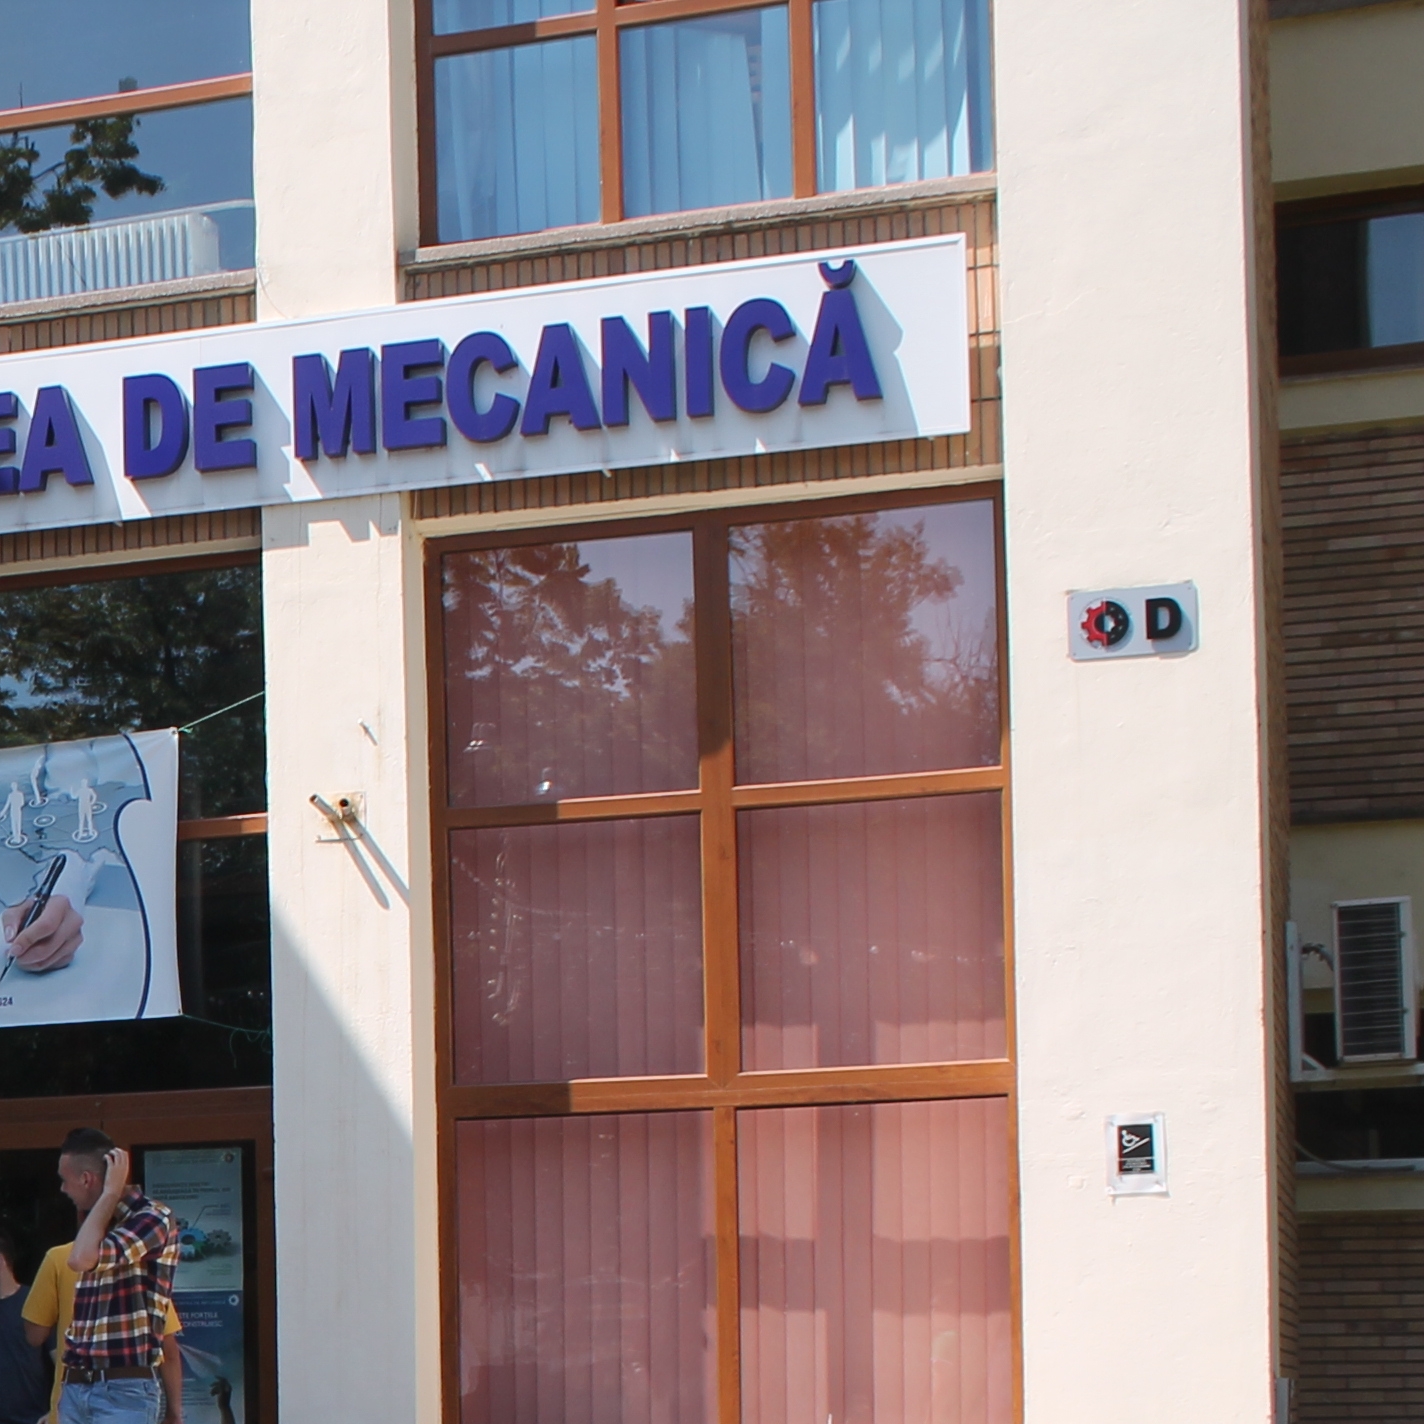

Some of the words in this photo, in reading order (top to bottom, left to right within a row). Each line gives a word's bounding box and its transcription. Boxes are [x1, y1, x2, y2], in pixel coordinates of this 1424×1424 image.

[122, 361, 258, 481] DE
[291, 261, 883, 462] MECANICĂ
[1145, 597, 1182, 640] D
